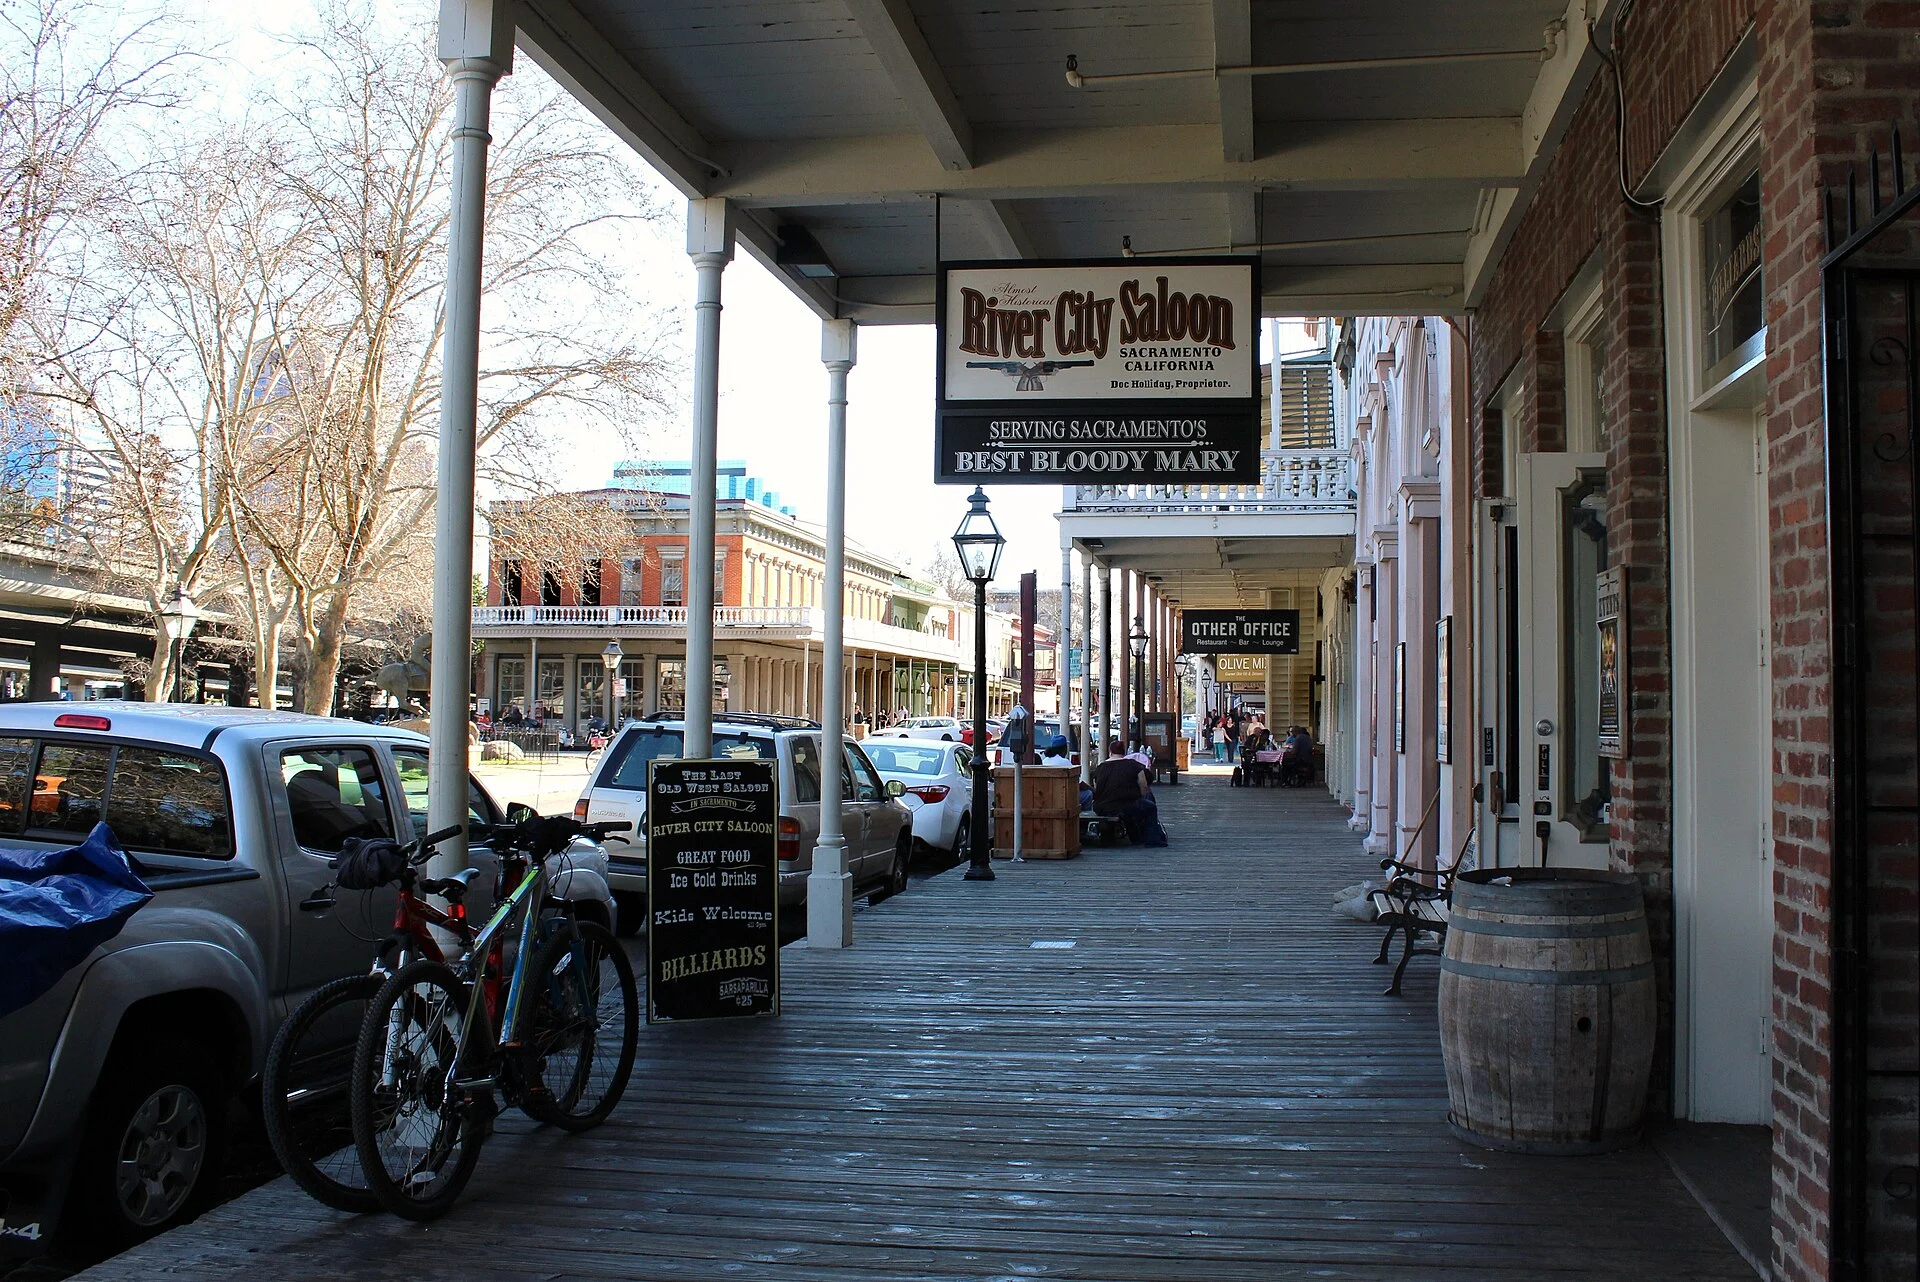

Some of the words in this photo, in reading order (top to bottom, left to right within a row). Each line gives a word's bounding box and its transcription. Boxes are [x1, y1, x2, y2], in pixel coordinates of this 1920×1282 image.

[992, 283, 1037, 296] Almost
[998, 294, 1057, 307] Historical
[959, 286, 1051, 359] River
[1055, 289, 1115, 359] City
[1119, 276, 1236, 350] Saloon
[1119, 347, 1222, 358] SACRAMENTO
[1124, 360, 1215, 371] CALIFORNIA
[1110, 380, 1130, 389] Doc
[1175, 379, 1231, 390] Proprietor.
[989, 420, 1066, 440] SERVING
[1069, 419, 1207, 439] SACRAMENTO'S
[954, 451, 1025, 473] BEST
[1029, 450, 1149, 473] BLOODY
[1154, 450, 1240, 472] MARY
[1192, 622, 1237, 636] OTHER
[1244, 622, 1290, 636] OFFICE
[1196, 638, 1228, 646] Restaurant
[1238, 638, 1249, 646] Bar
[1262, 639, 1284, 647] Lounge
[1219, 658, 1250, 669] OLIVE
[1252, 658, 1266, 669] MI
[682, 770, 707, 781] THE
[710, 769, 742, 781] LAST
[657, 783, 682, 794] OLD
[685, 782, 720, 794] WEST
[723, 782, 769, 793] SALOON
[690, 800, 698, 808] IN
[700, 798, 737, 808] SACRAMENTO
[653, 822, 691, 837] RIVER
[694, 821, 724, 832] CITY
[727, 821, 773, 834] SALOON
[677, 850, 716, 864] GREAT
[720, 850, 750, 863] FOOD
[670, 873, 688, 888] Ice
[693, 872, 716, 887] Cold
[721, 871, 757, 886] Drinks
[655, 909, 694, 924] Kids
[702, 906, 773, 921] Welcome
[661, 945, 766, 982] BILLIARDS
[719, 982, 768, 996] SARSAPARILLA
[0, 1218, 42, 1240] x4
